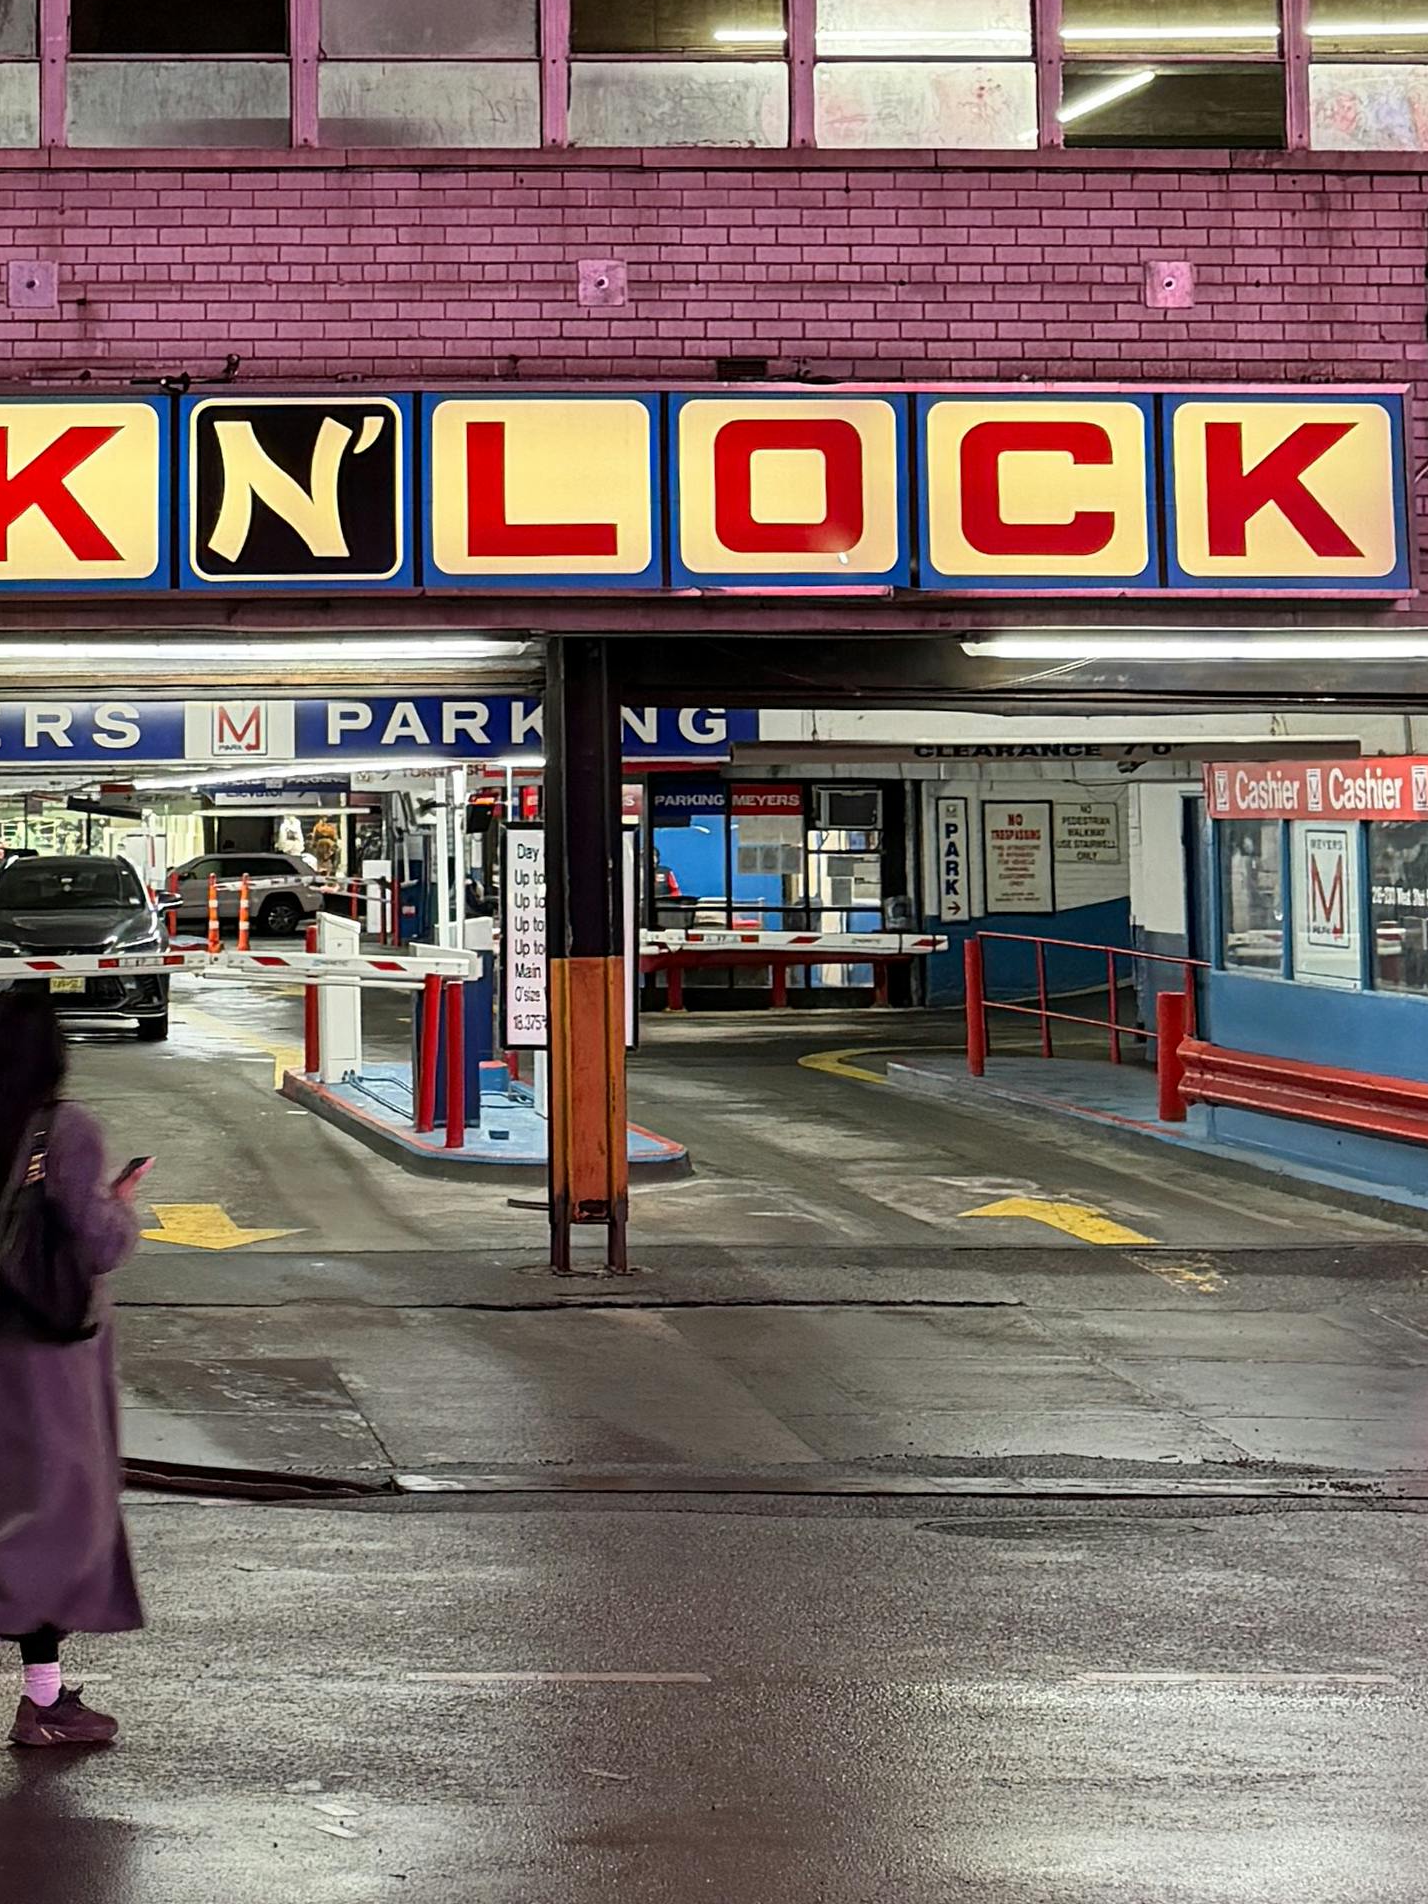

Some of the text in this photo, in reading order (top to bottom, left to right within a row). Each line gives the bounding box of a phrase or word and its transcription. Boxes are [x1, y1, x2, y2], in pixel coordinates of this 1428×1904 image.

[208, 416, 384, 563] N'
[466, 419, 1364, 558] LOCK
[326, 701, 729, 745] PARKNG
[913, 744, 1103, 758] CLEARANCE
[1235, 767, 1403, 810] Cashier Cashier
[654, 794, 725, 807] PARKING
[732, 794, 801, 807] MEYERS
[1007, 814, 1023, 826] NO
[517, 843, 539, 863] Day
[944, 823, 960, 896] PARK
[514, 869, 546, 886] Up to
[514, 893, 546, 910] Up to
[514, 916, 545, 933] Up to
[514, 939, 545, 956] Up to
[515, 963, 542, 979] Main
